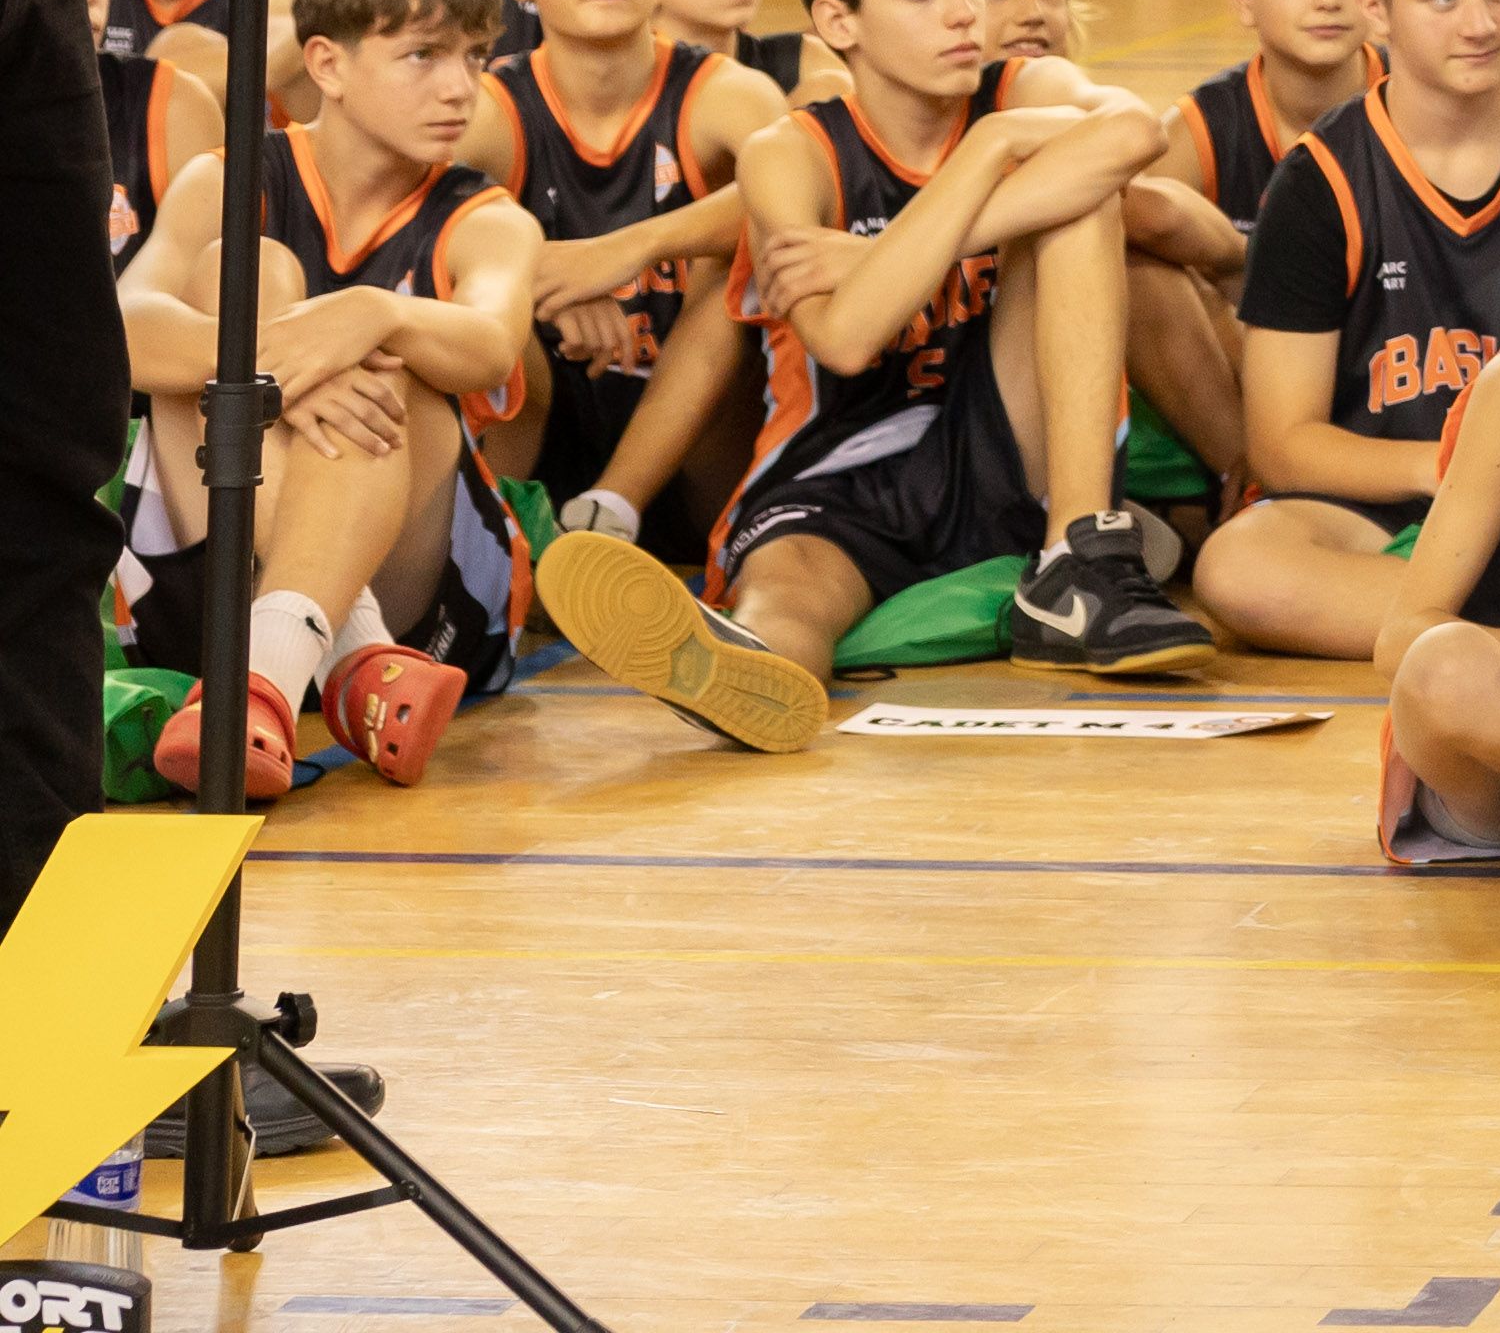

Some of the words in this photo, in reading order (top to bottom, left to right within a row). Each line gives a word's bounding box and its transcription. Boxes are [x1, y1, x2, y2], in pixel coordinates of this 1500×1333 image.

[1381, 261, 1408, 275] ARC
[1383, 276, 1407, 291] ART
[867, 716, 1063, 729] CADET
[1074, 722, 1124, 730] M
[0, 1279, 133, 1331] ORT
